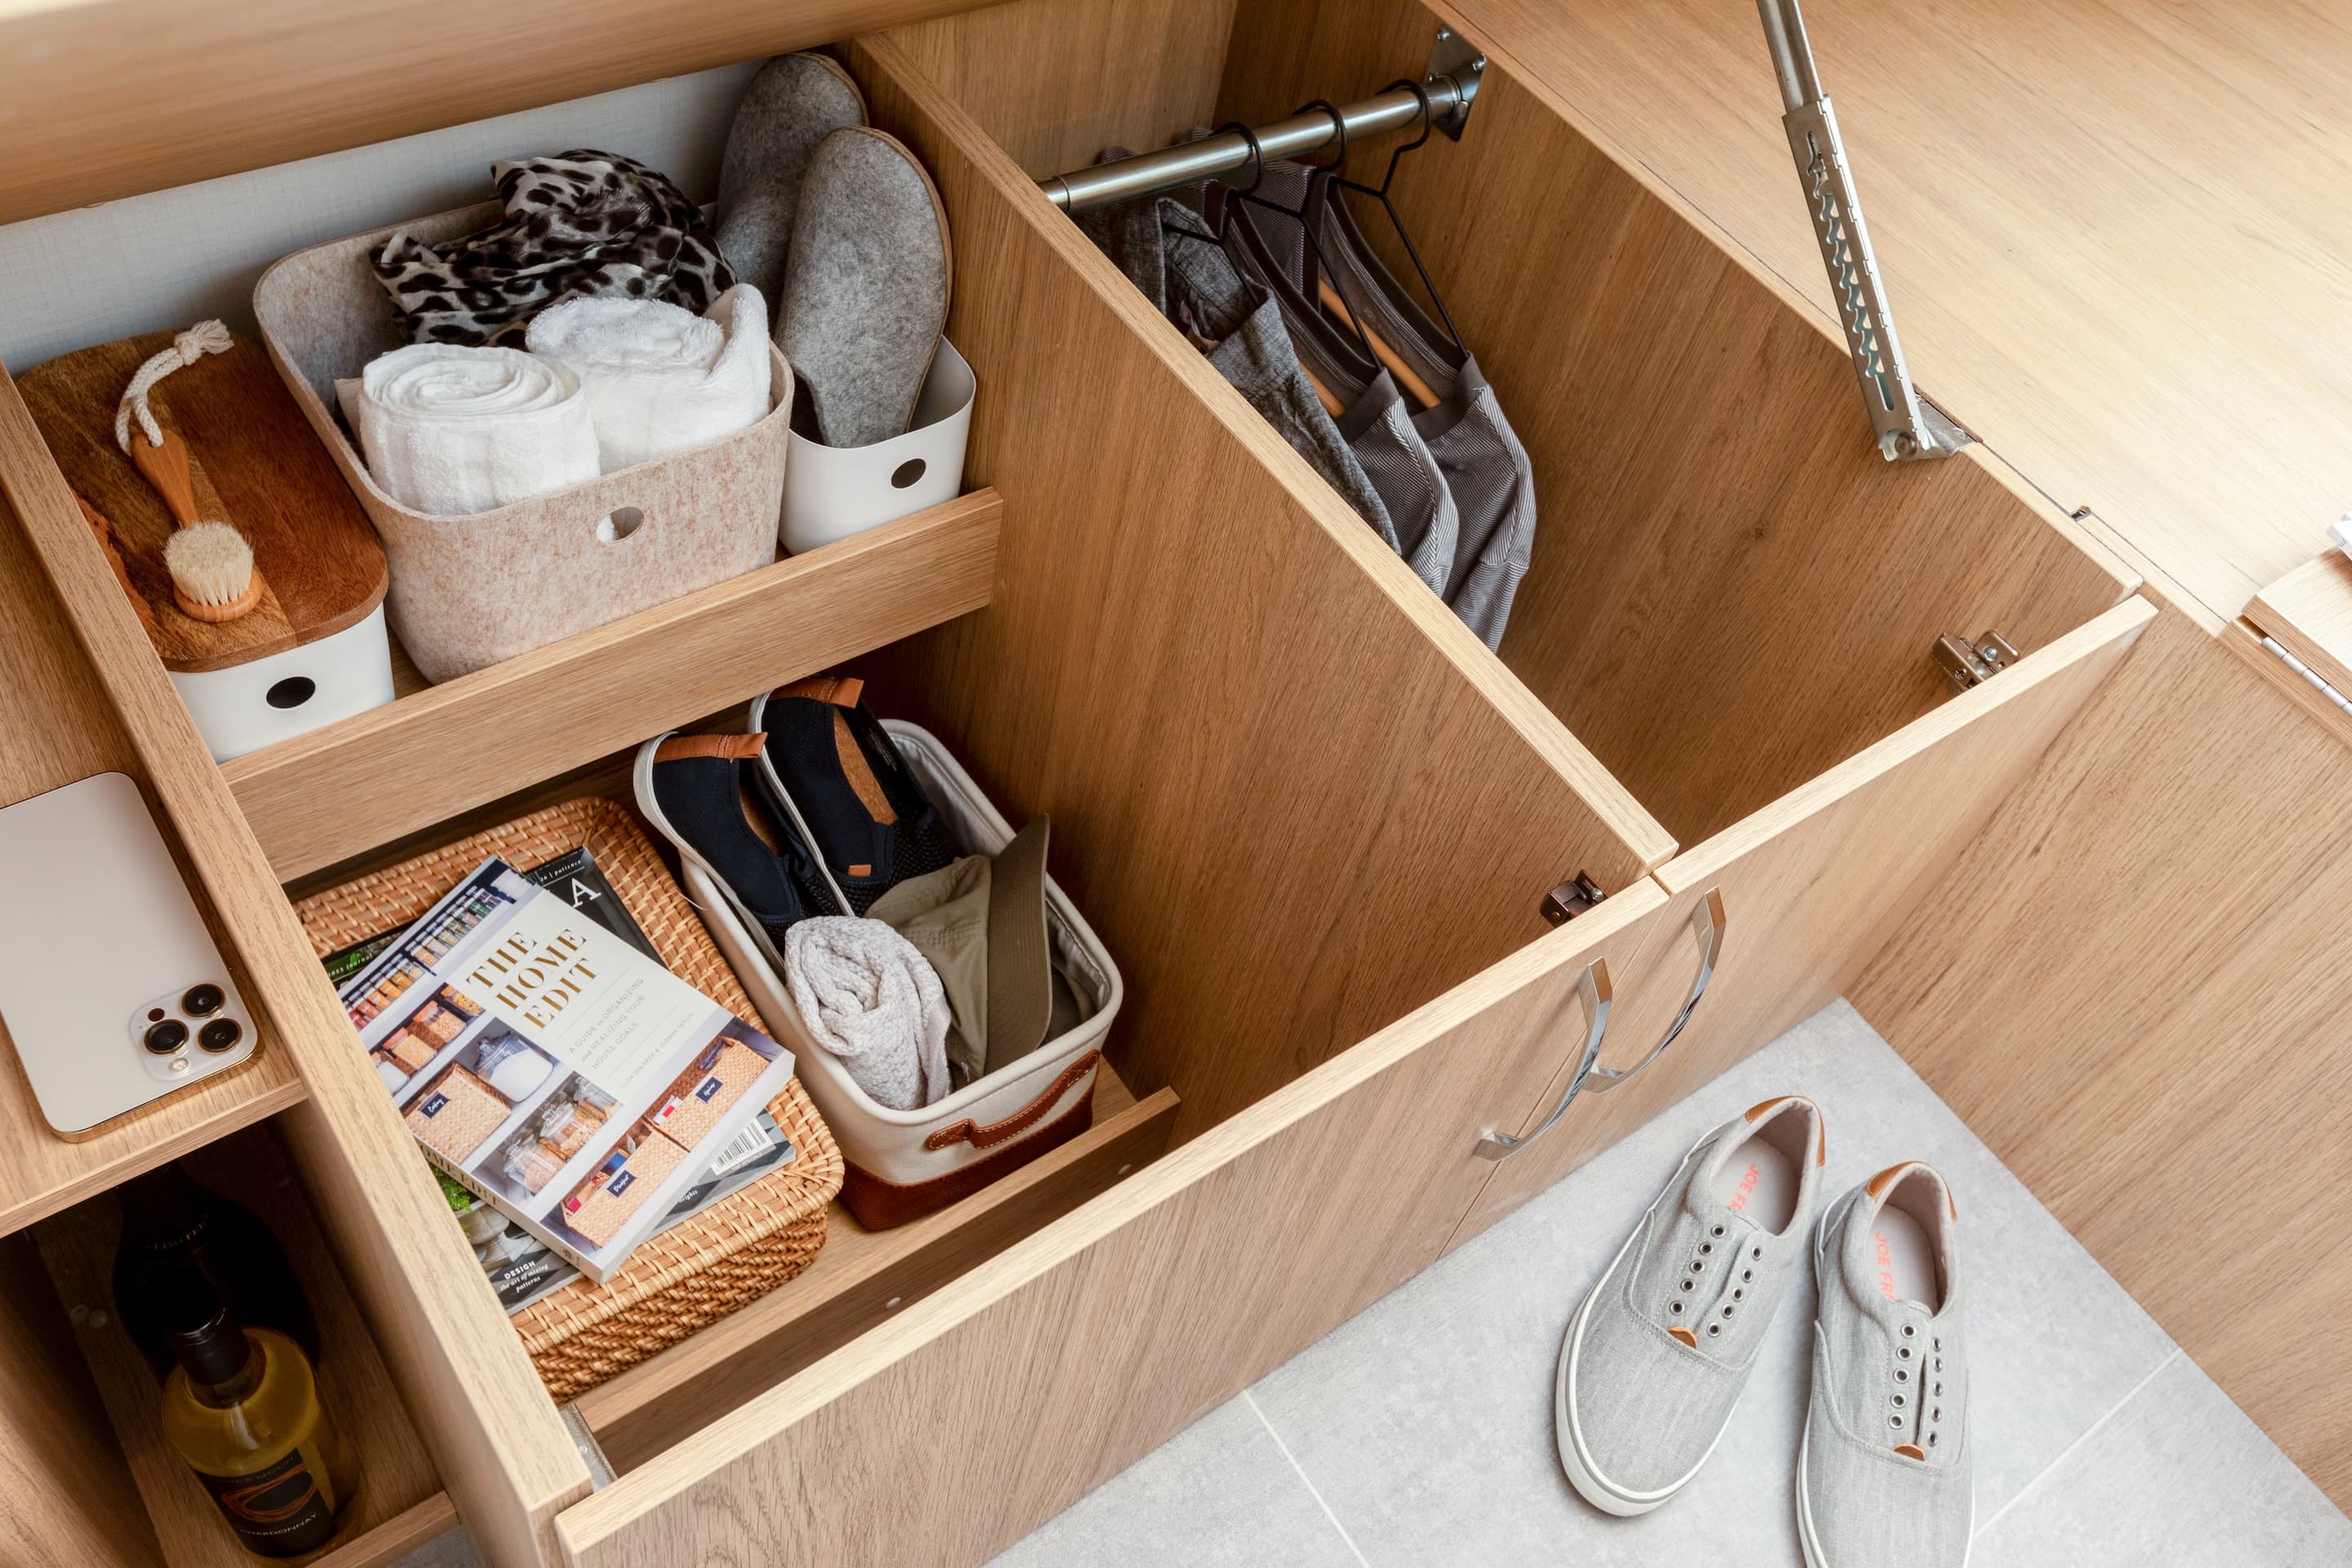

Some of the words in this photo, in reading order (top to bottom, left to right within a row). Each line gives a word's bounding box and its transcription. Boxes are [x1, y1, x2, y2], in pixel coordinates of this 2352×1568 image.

[554, 859, 581, 876] patience
[345, 952, 372, 970] journal
[466, 932, 537, 988] THE
[496, 929, 587, 1010] HOME
[523, 957, 597, 1029] EDIT
[574, 1024, 596, 1049] GUIDE
[601, 978, 644, 1020] ORGANIZING
[590, 1013, 628, 1051] REALIZING
[626, 995, 645, 1014] YOUR
[591, 1045, 617, 1070] HOUSE
[614, 1021, 640, 1046] GOALS
[1739, 1163, 1761, 1194] JOE
[1874, 1231, 1891, 1267] JOE
[500, 1282, 510, 1292] the
[510, 1276, 521, 1286] art
[520, 1271, 528, 1282] of
[528, 1263, 550, 1276] mixing
[503, 1260, 536, 1280] DESIGN
[515, 1276, 541, 1294] patterns
[239, 1512, 317, 1536] CHARDONNAY
